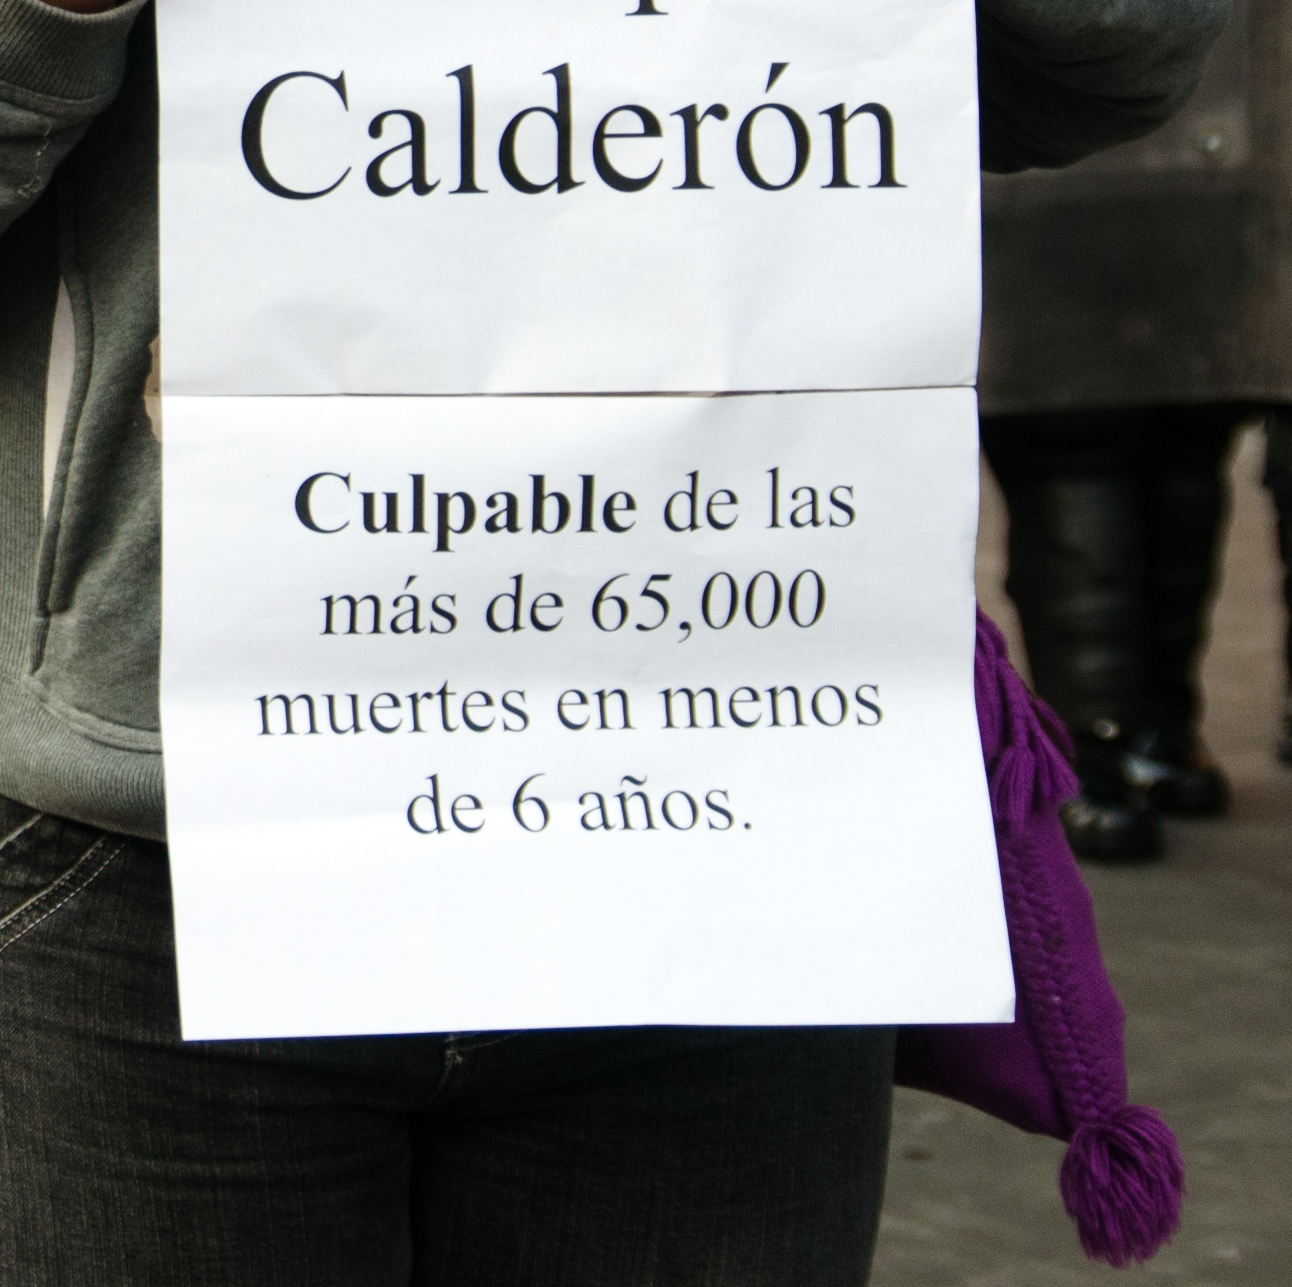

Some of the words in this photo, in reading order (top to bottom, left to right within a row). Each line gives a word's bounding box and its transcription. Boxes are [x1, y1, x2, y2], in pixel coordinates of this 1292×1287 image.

[240, 61, 907, 200] Calderón
[293, 471, 637, 552] Culpable
[662, 469, 739, 533] de
[766, 466, 856, 529] las
[319, 575, 458, 636] más
[484, 573, 564, 633] de
[590, 569, 826, 643] 65,000
[255, 681, 529, 736] muertes
[556, 686, 633, 732] en
[659, 681, 883, 729] menos
[405, 773, 484, 835] de
[510, 773, 551, 832] 6
[577, 774, 751, 832] años.
